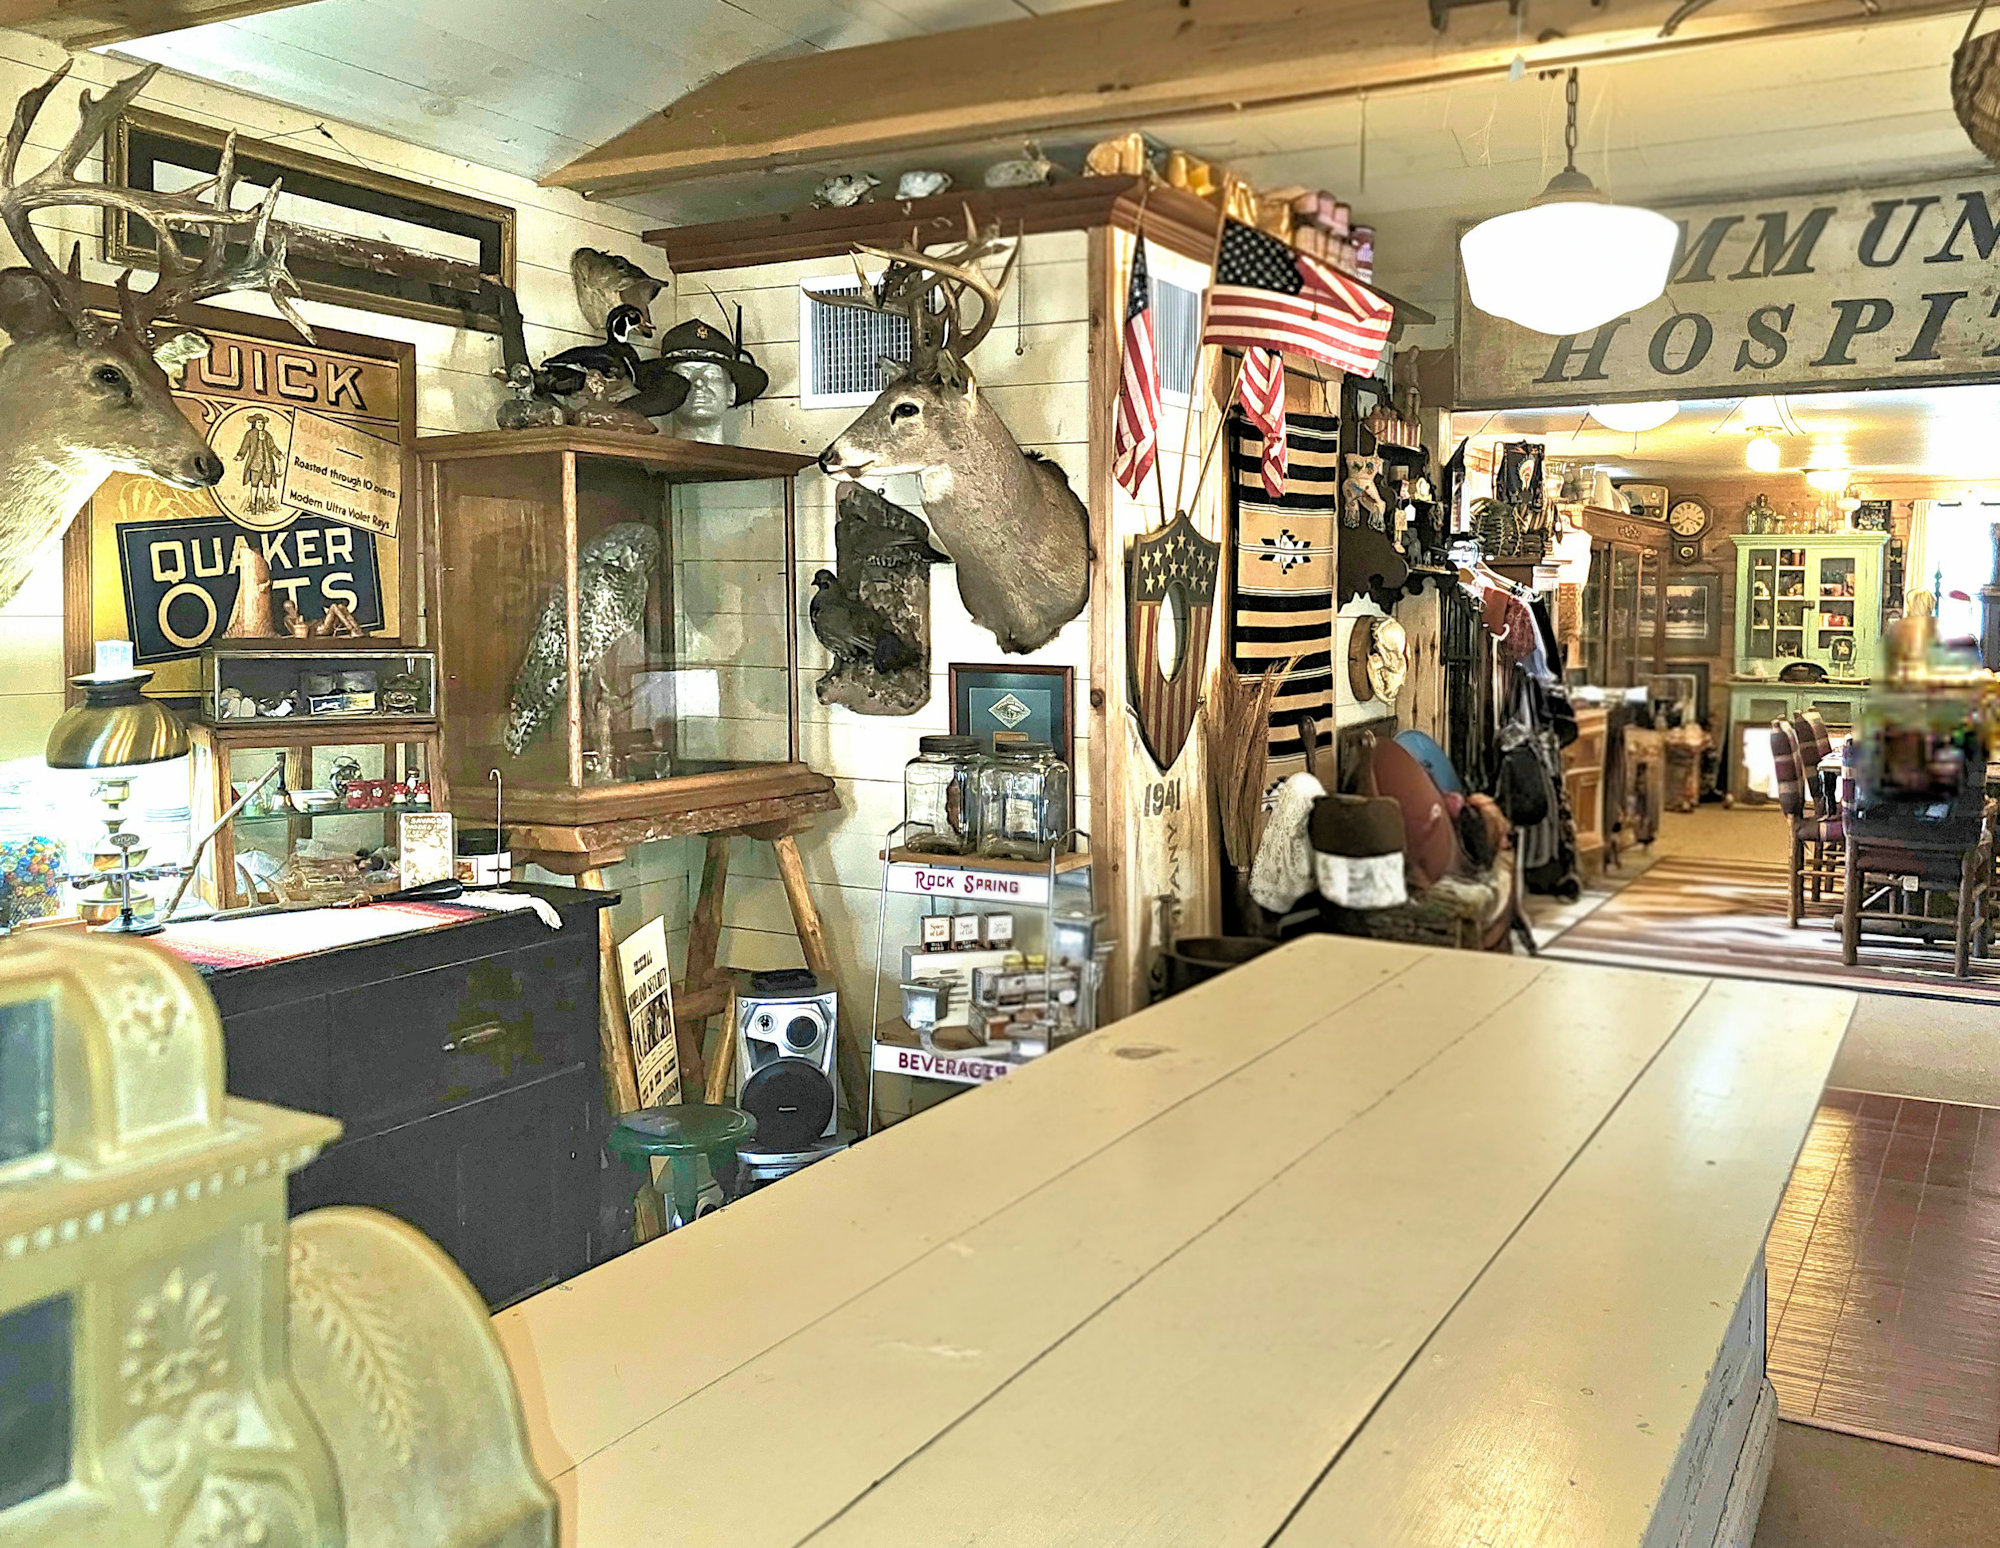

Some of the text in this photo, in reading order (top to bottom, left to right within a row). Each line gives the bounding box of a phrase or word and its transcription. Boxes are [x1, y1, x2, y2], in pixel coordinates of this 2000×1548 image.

[1667, 190, 2000, 285] MMUN
[1532, 291, 2000, 384] HOSPI
[169, 345, 367, 412] UICK
[294, 456, 328, 476] Roasted
[330, 469, 361, 487] through
[363, 479, 373, 490] 10
[373, 485, 396, 499] ovens
[289, 489, 323, 509] Modern
[326, 500, 346, 516] Ultra
[348, 507, 370, 523] Violet
[372, 515, 390, 531] Rays
[150, 526, 354, 584] QUAKER
[158, 572, 358, 648] OTS
[1144, 777, 1181, 817] 1941
[915, 871, 1019, 894] ROCK SPRING
